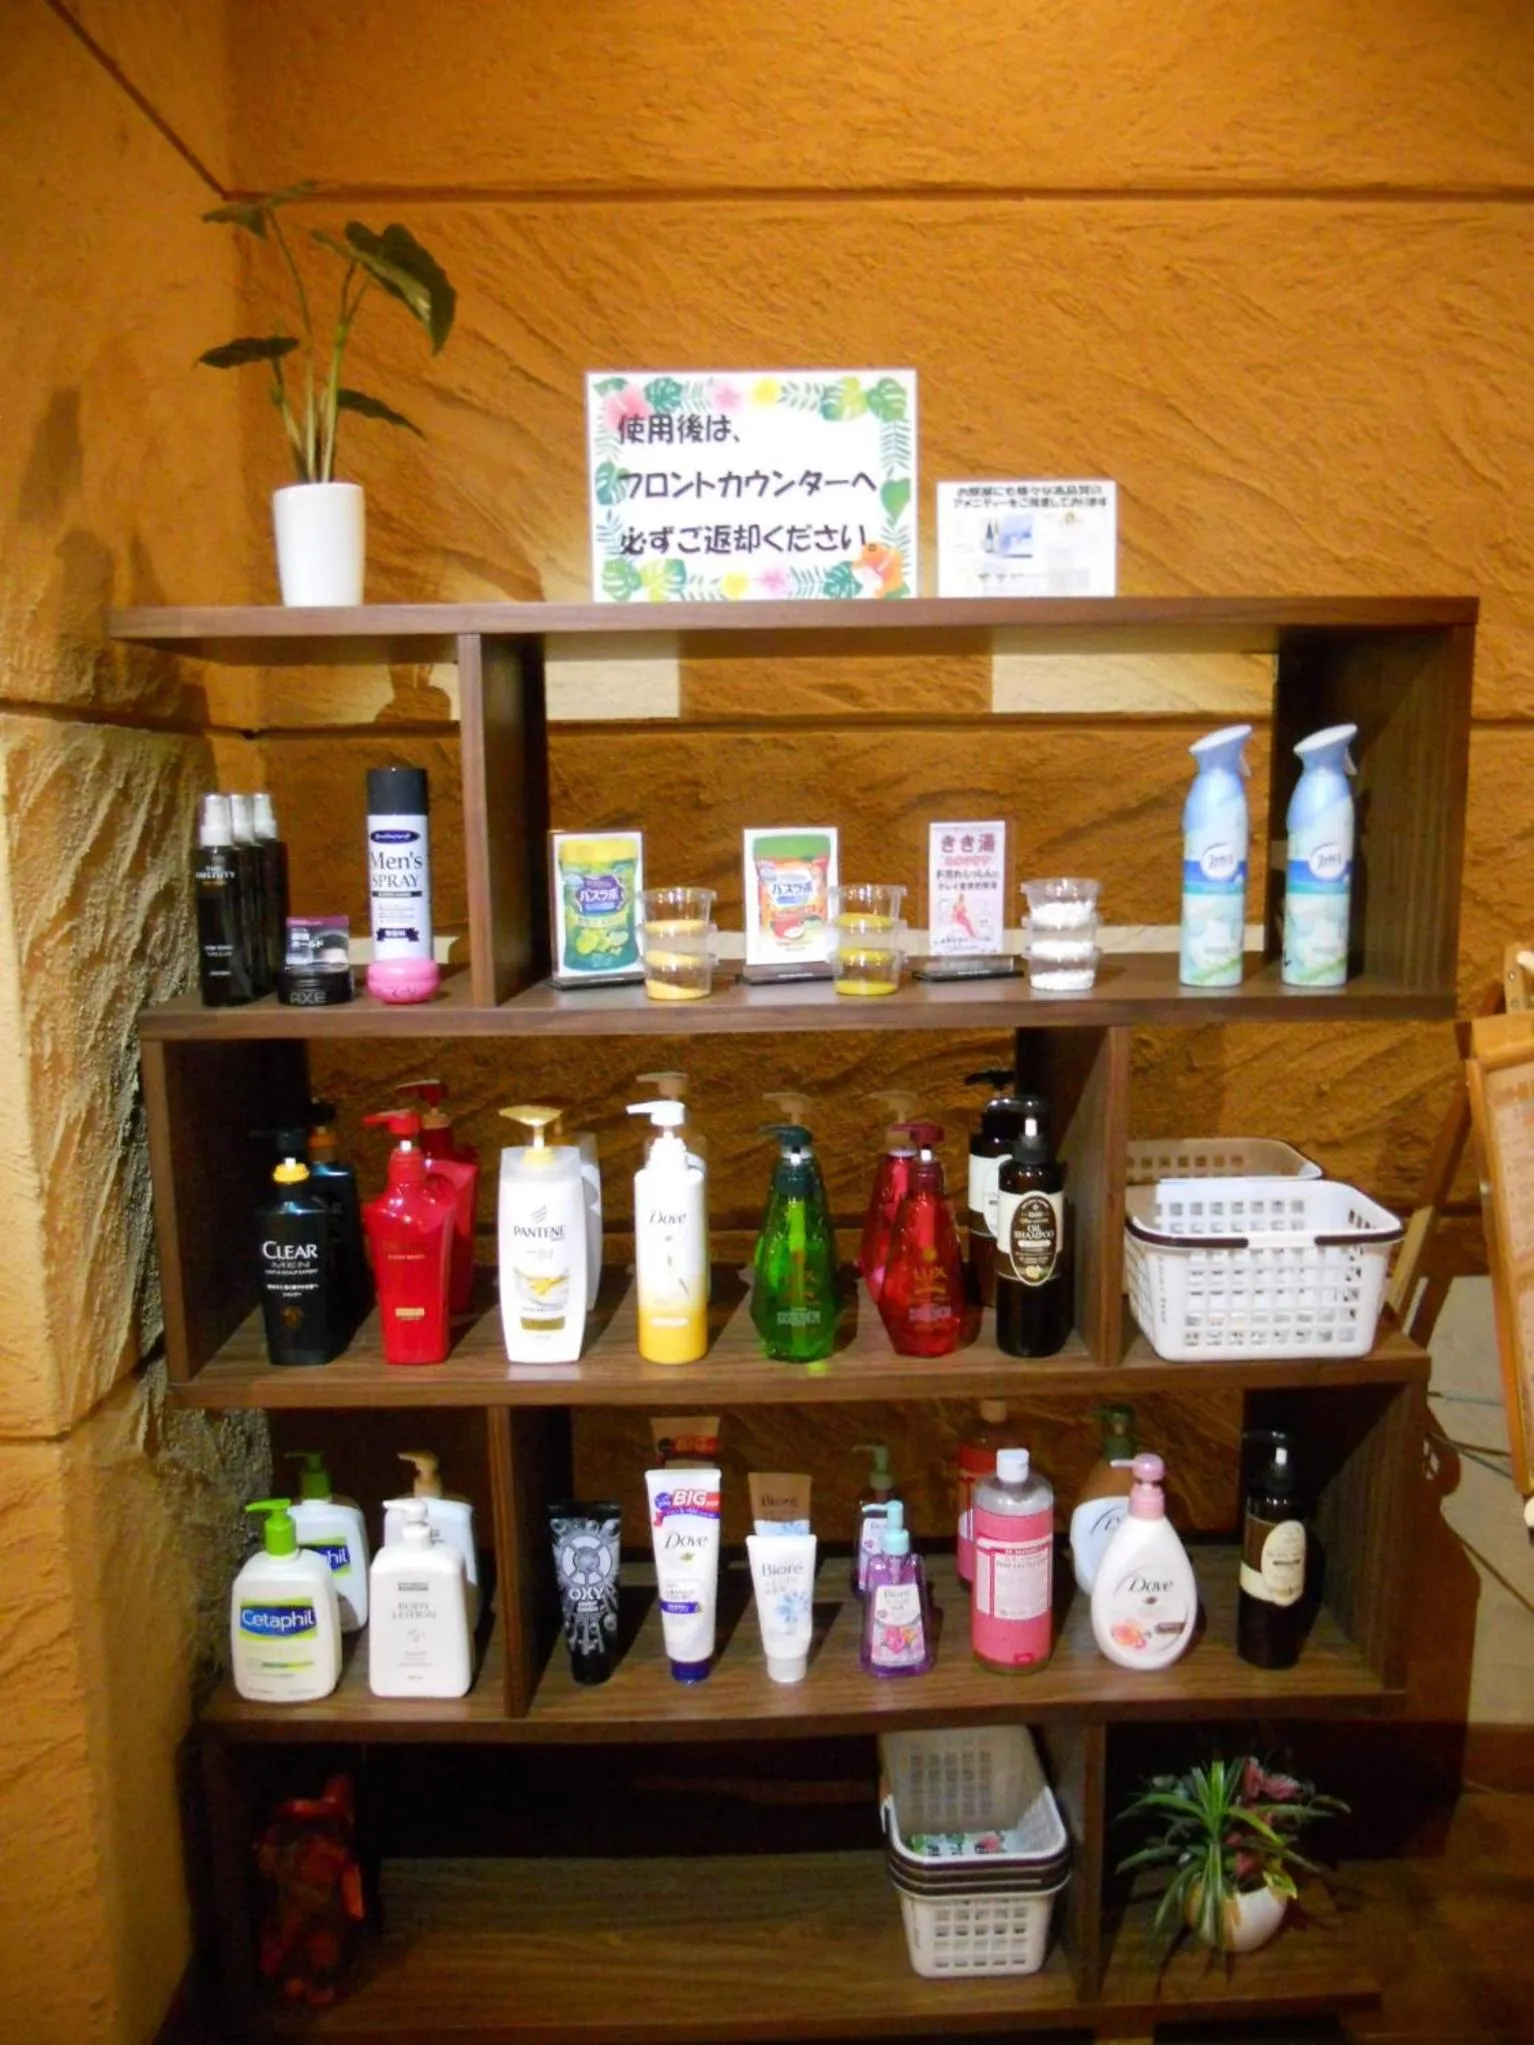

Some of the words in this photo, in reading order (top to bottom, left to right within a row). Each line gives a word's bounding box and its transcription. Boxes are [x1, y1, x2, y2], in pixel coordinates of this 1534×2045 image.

[618, 414, 741, 445] 使用後は、
[618, 470, 877, 499] フロントカウンターへ
[941, 834, 995, 853] きき湯
[372, 874, 419, 888] SPRAY
[290, 991, 327, 1005] AXE
[650, 1207, 687, 1225] Dove
[513, 1225, 566, 1238] PANTENE
[262, 1240, 319, 1260] CLEAR
[673, 1488, 708, 1506] BIG
[664, 1530, 708, 1550] Dove
[569, 1586, 606, 1601] OXY
[1129, 1578, 1174, 1593] Dove
[241, 1608, 315, 1633] Cetaphil
